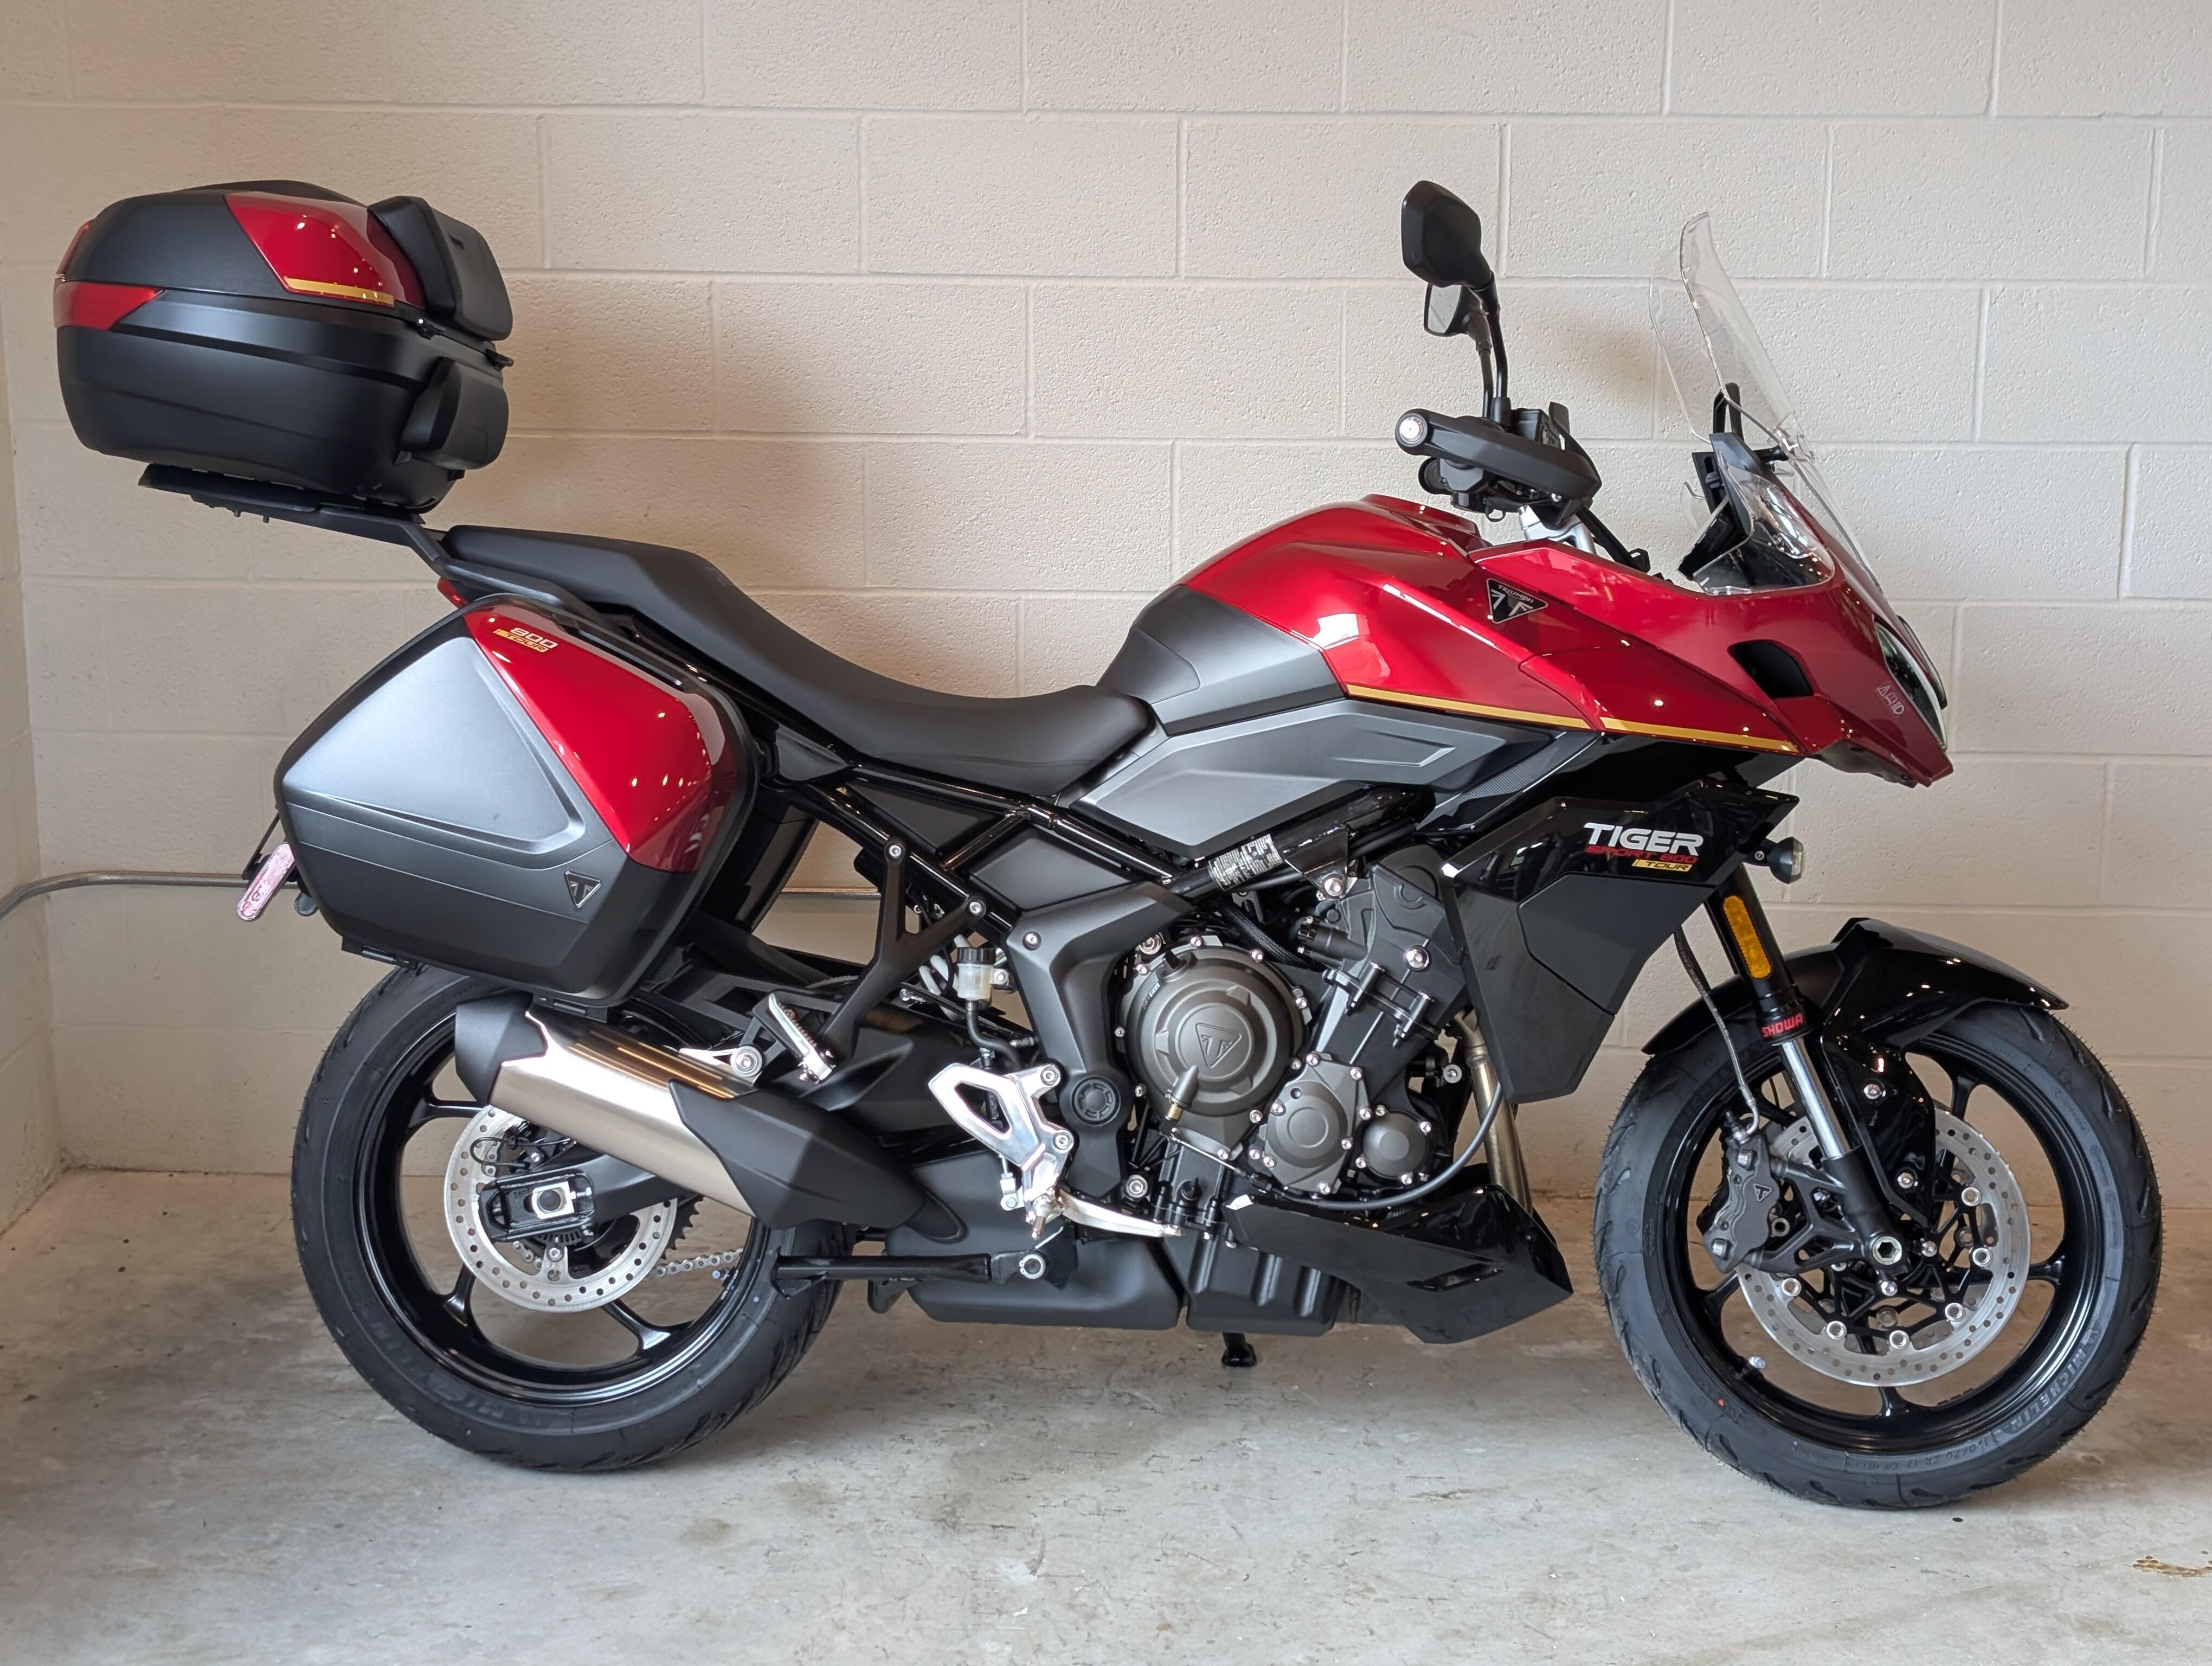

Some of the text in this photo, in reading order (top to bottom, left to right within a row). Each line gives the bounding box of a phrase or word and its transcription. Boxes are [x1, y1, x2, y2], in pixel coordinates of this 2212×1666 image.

[1498, 585, 1534, 603] TRIUMPH
[506, 634, 546, 651] TOUR
[510, 627, 558, 649] 800
[1584, 822, 1703, 856] TIGER
[1585, 845, 1699, 863] SPORT 800
[1646, 861, 1689, 870] TOUR
[1761, 1013, 1804, 1038] SHOWA
[2011, 1348, 2086, 1430] MICHELIN
